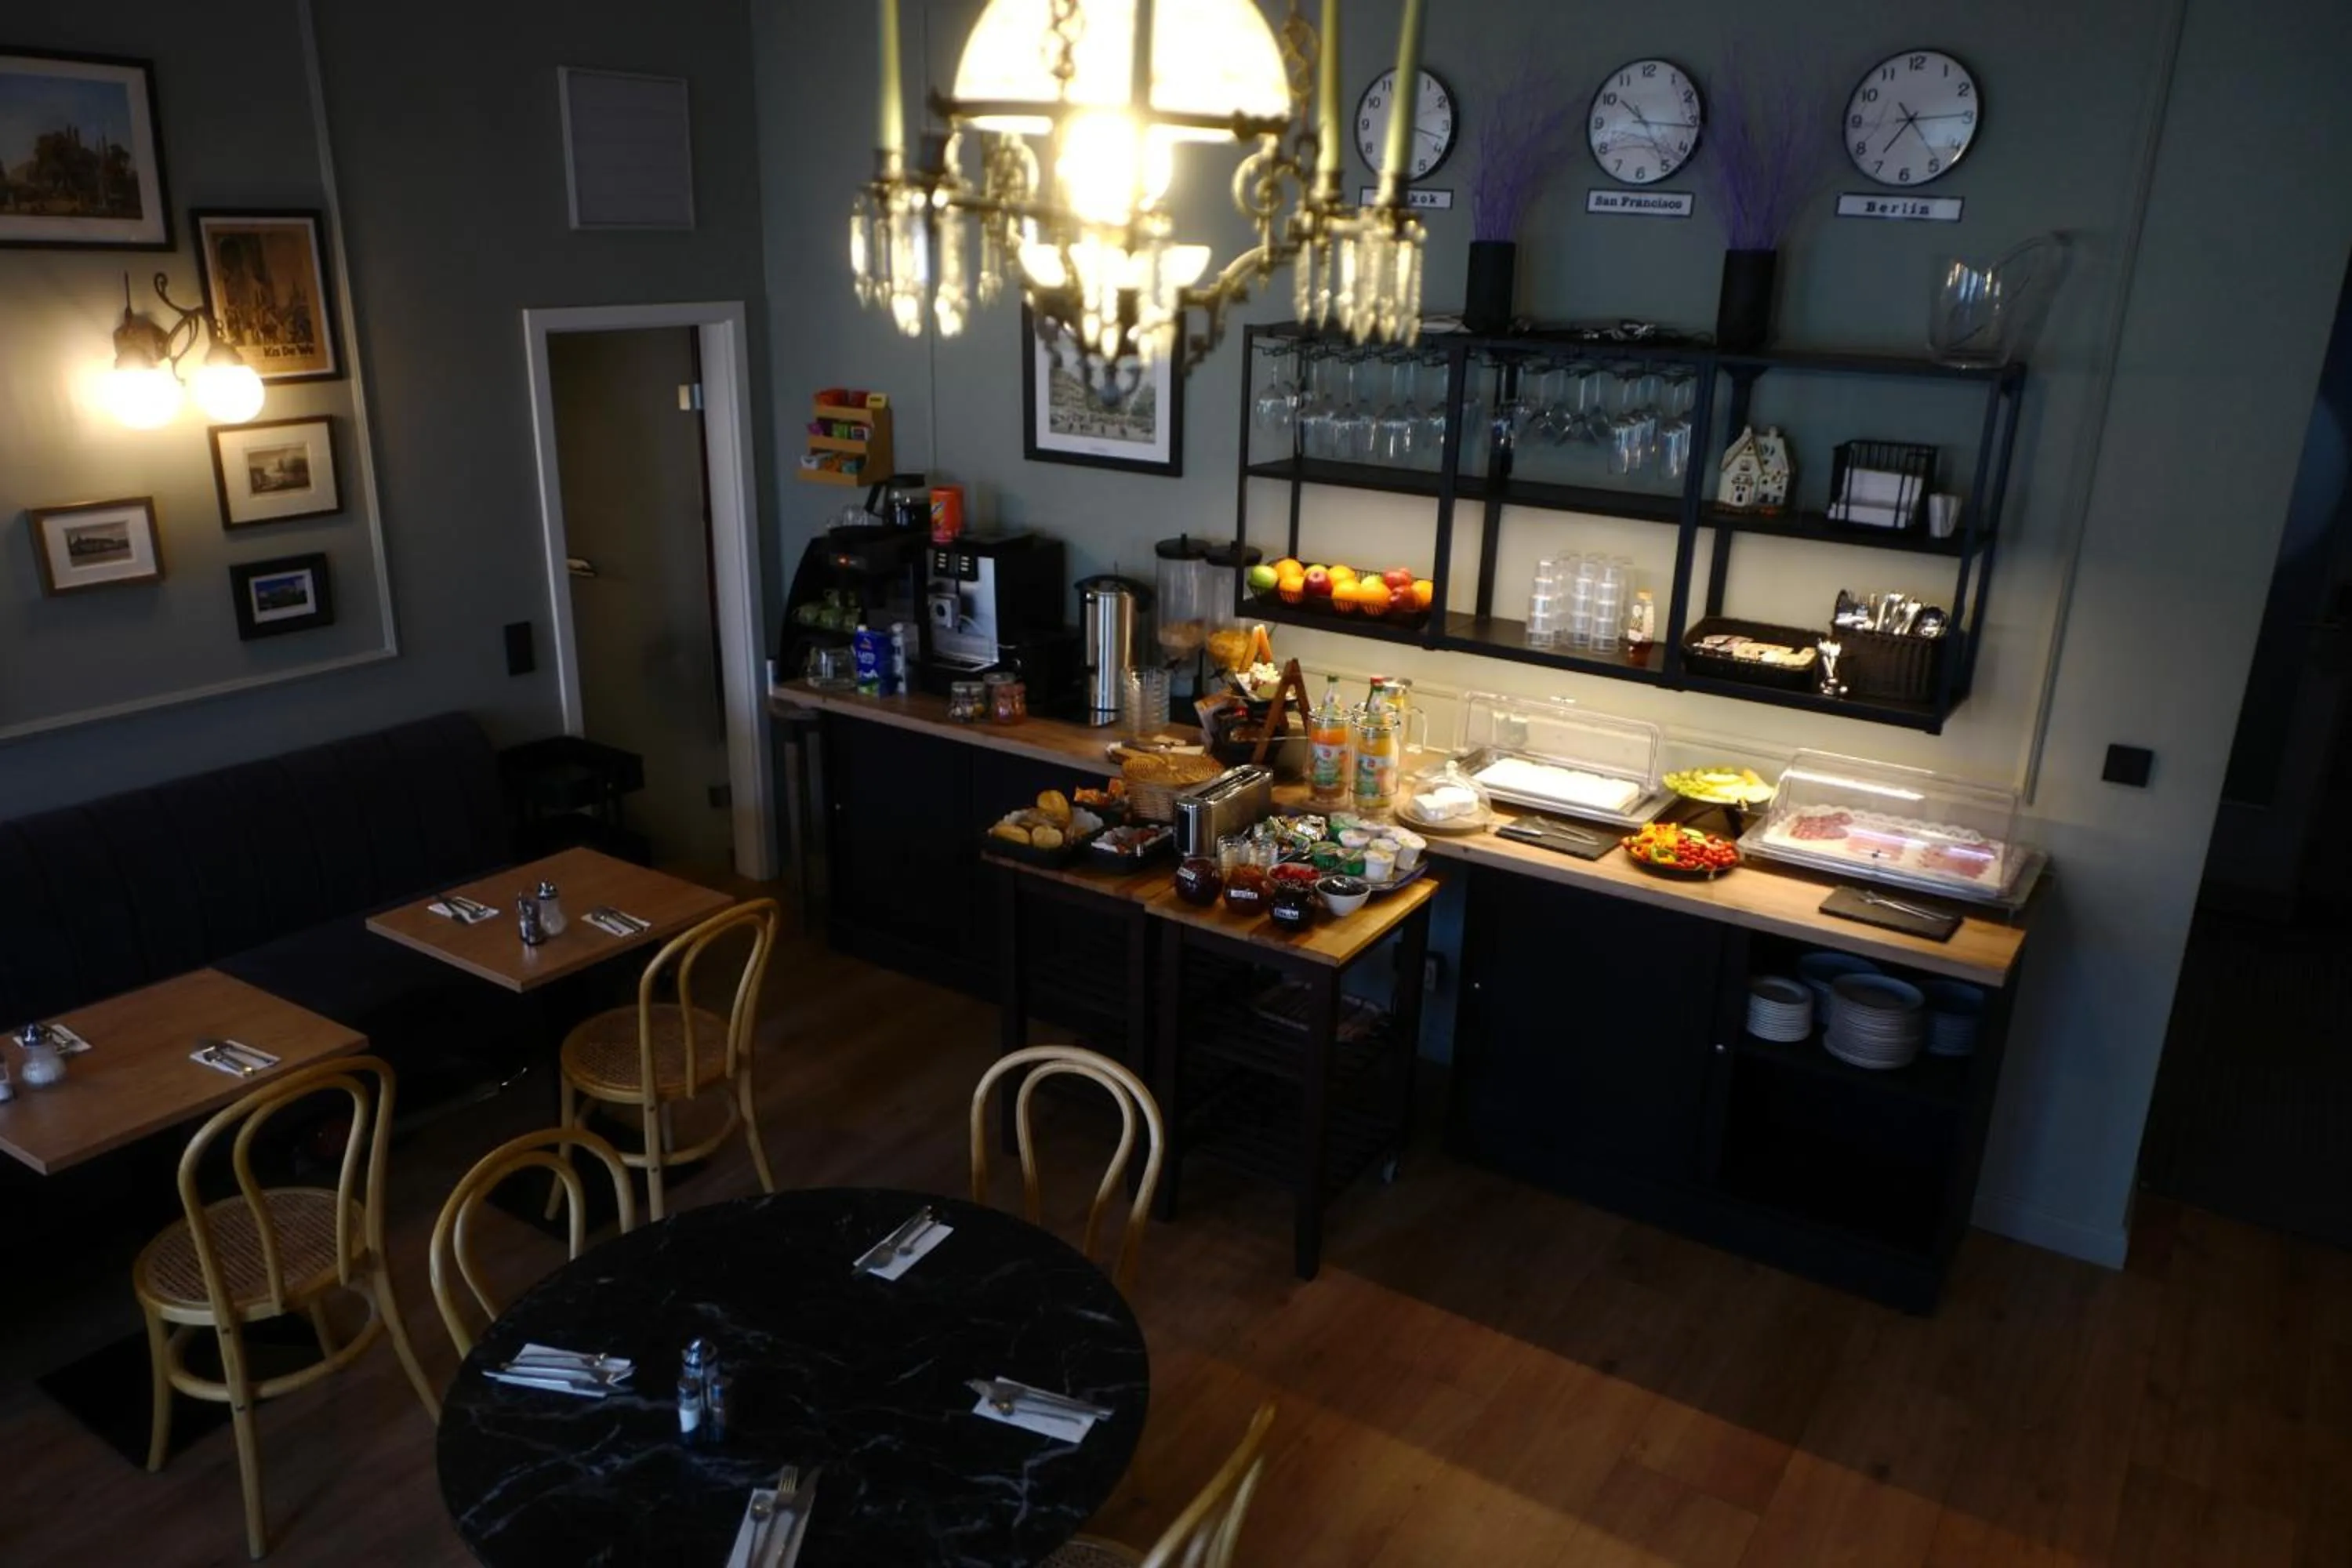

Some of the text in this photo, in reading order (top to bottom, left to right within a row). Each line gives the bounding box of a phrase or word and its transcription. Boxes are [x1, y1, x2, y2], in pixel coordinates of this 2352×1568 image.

[1908, 56, 1926, 71] 12
[1642, 64, 1657, 78] 12
[1882, 68, 1895, 82] 11
[1944, 64, 1948, 77] 1
[1619, 74, 1631, 87] 11
[1670, 74, 1675, 85] 1
[1682, 89, 1694, 103] 2
[1861, 88, 1878, 102] 10
[1958, 82, 1970, 97] 2
[1368, 96, 1381, 109] 10
[1437, 95, 1446, 109] 2
[1602, 93, 1617, 106] 10
[1362, 118, 1370, 130] 9
[1594, 117, 1605, 130] 9
[1689, 114, 1698, 128] 3
[1851, 114, 1862, 129] 9
[1961, 111, 1974, 124] 3
[1442, 119, 1450, 132] 3
[1365, 142, 1373, 154] 8
[1434, 143, 1442, 153] 4
[1598, 142, 1609, 154] 8
[1678, 141, 1688, 153] 4
[1856, 141, 1867, 155] 8
[1418, 159, 1426, 172] 5
[1613, 159, 1623, 172] 7
[1660, 159, 1671, 172] 5
[1873, 161, 1884, 175] 7
[1927, 158, 1940, 173] 5
[1635, 167, 1645, 180] 6
[1898, 168, 1911, 182] 6
[1595, 196, 1682, 209] San Francisco
[1865, 201, 1930, 215] Berlin
